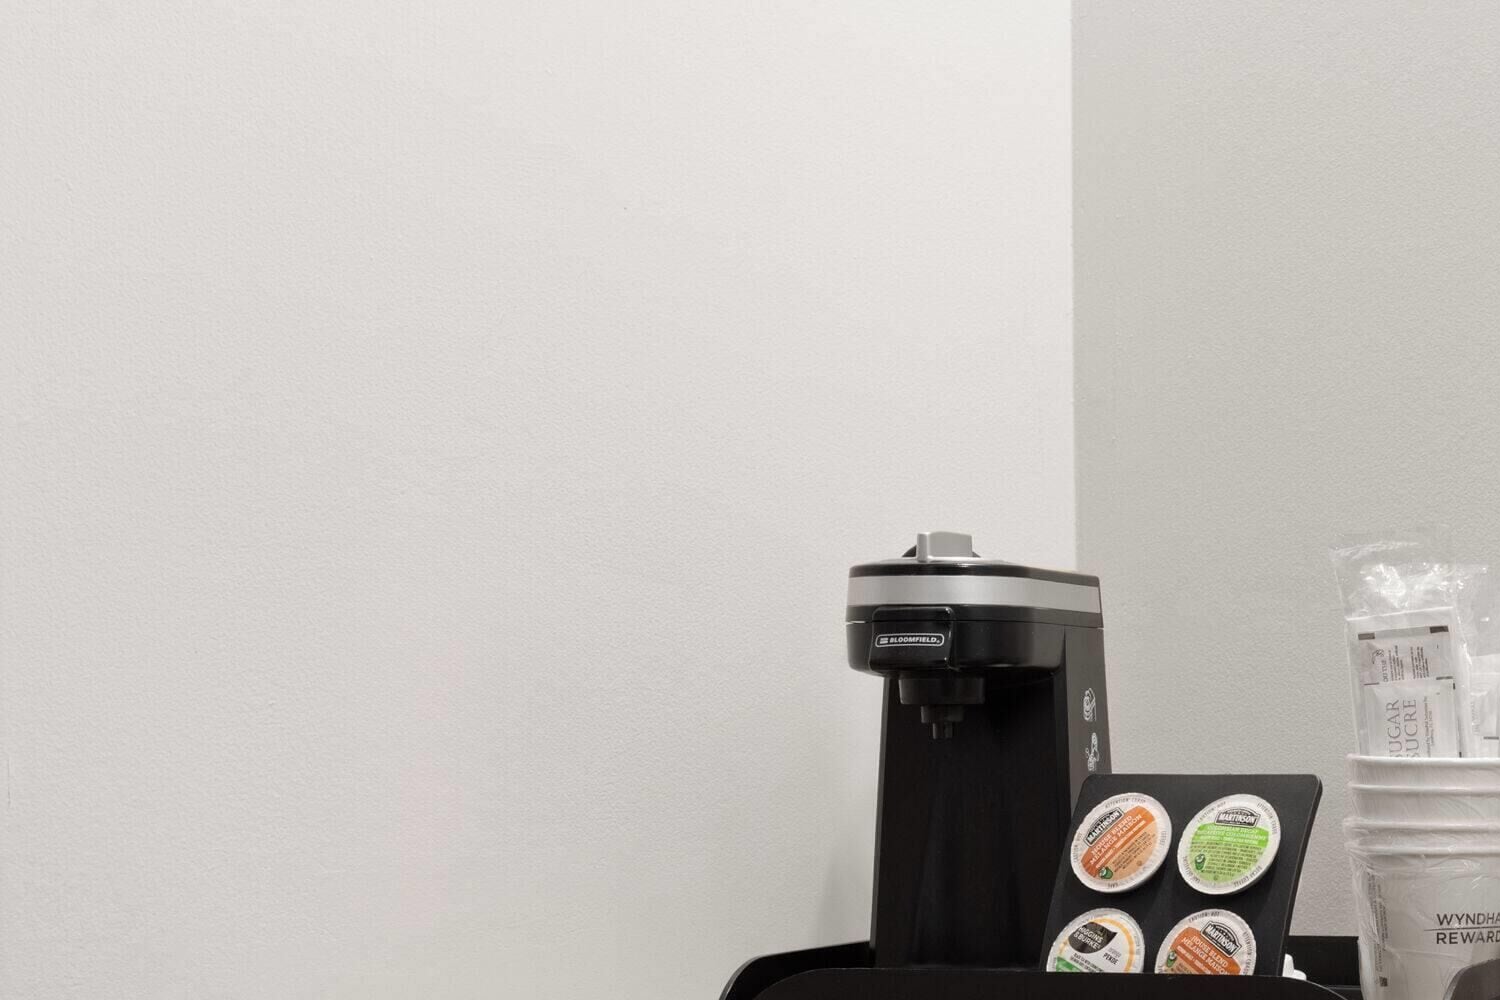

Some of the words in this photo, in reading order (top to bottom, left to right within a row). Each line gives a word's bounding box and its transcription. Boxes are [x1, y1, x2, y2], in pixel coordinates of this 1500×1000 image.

[1087, 810, 1120, 841] MARTINSON
[1218, 813, 1256, 824] MARTINSON
[1204, 924, 1237, 953] MARTINSON
